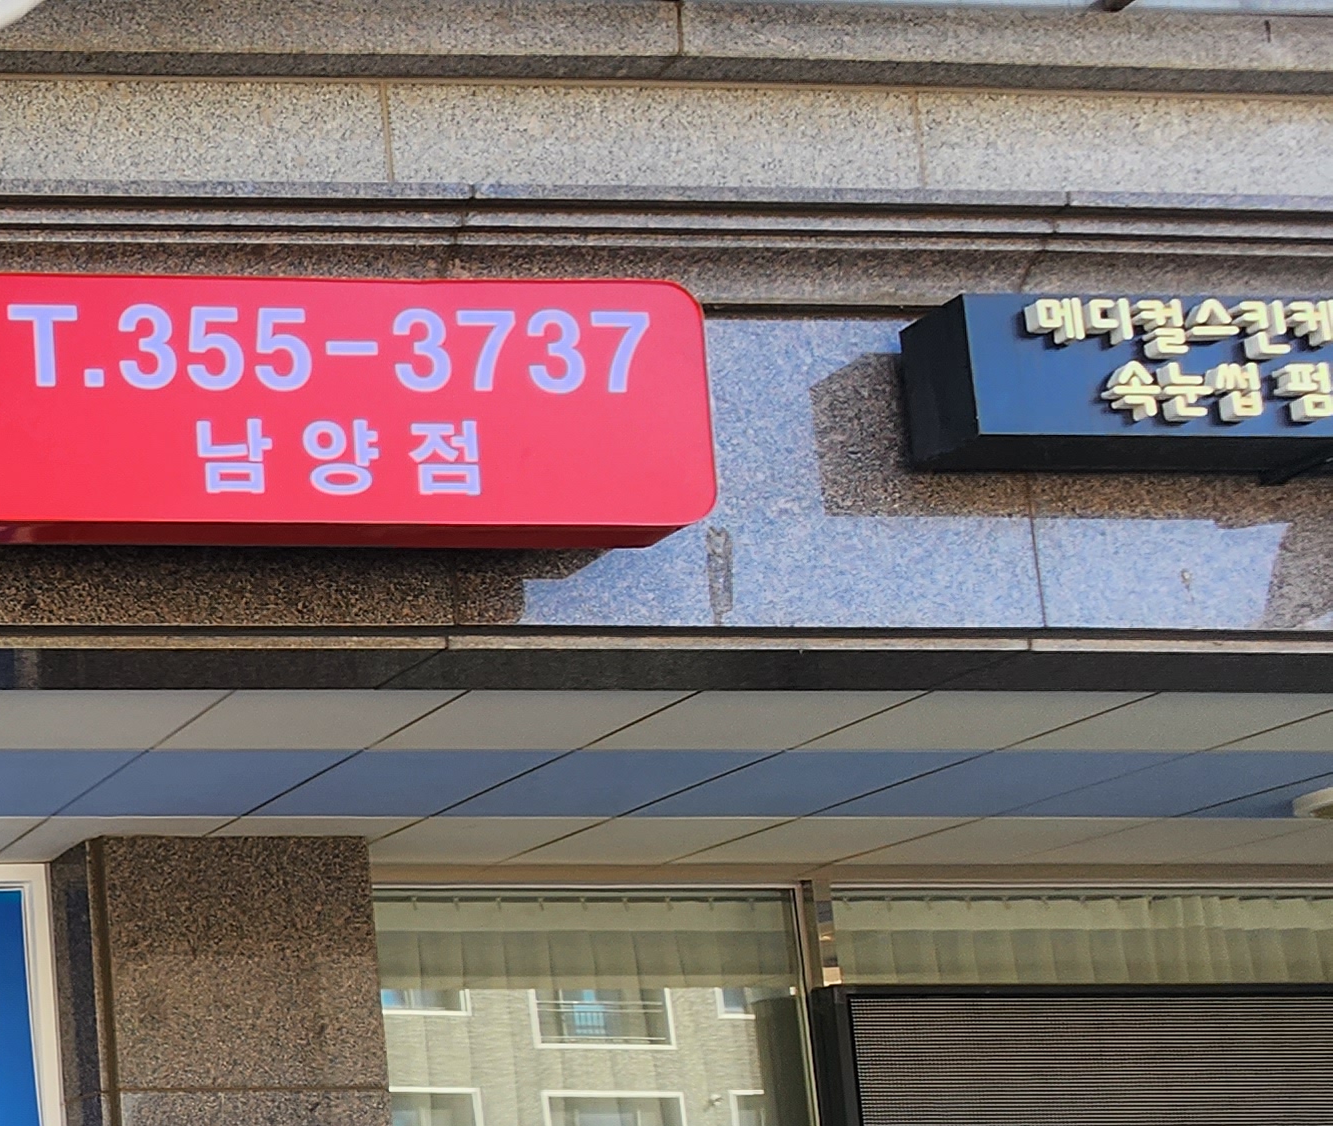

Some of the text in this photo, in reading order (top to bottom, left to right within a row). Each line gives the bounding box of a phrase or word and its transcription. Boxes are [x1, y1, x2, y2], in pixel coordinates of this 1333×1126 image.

[6, 303, 651, 394] T.355-3737
[1101, 360, 1264, 422] 속눈썹
[195, 418, 483, 497] 남양점
